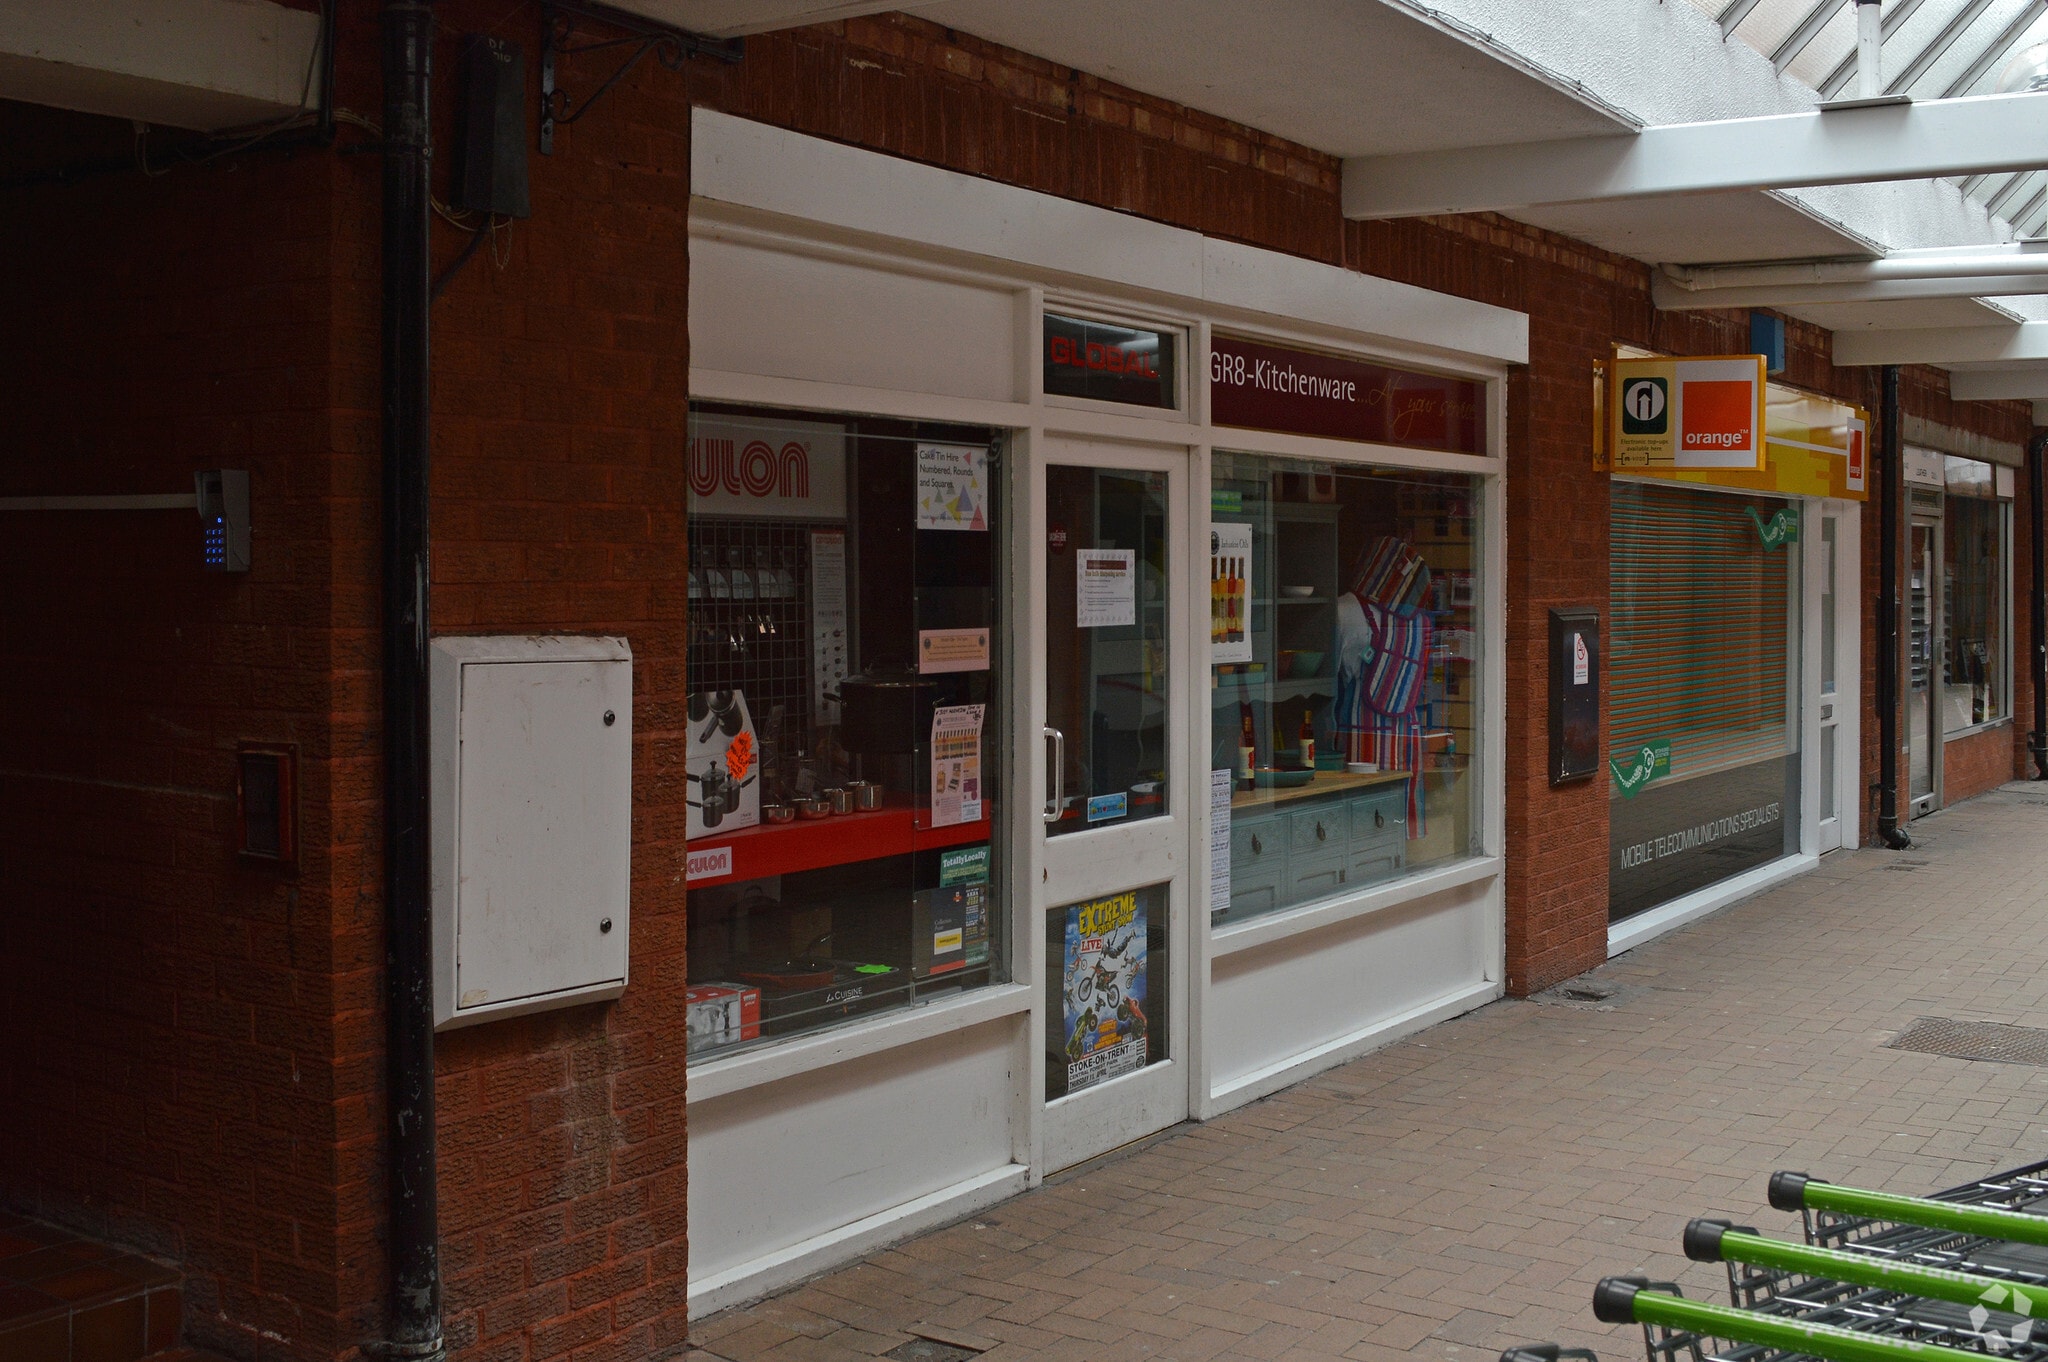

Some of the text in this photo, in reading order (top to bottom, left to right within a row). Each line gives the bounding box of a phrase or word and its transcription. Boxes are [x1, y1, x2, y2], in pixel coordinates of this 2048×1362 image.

[1050, 336, 1158, 379] GLOBAL
[1686, 432, 1742, 448] orange
[919, 450, 959, 462] Cake Tin Hire
[953, 466, 974, 477] Rounds
[919, 479, 930, 487] and
[1621, 802, 1780, 870] MOBILE TELECOMMUNICATIONS SPECIALISTS
[1079, 891, 1137, 938] EXTREME
[1081, 939, 1102, 952] LIVE
[1069, 1045, 1129, 1075] STOKE-ON-TRENT
